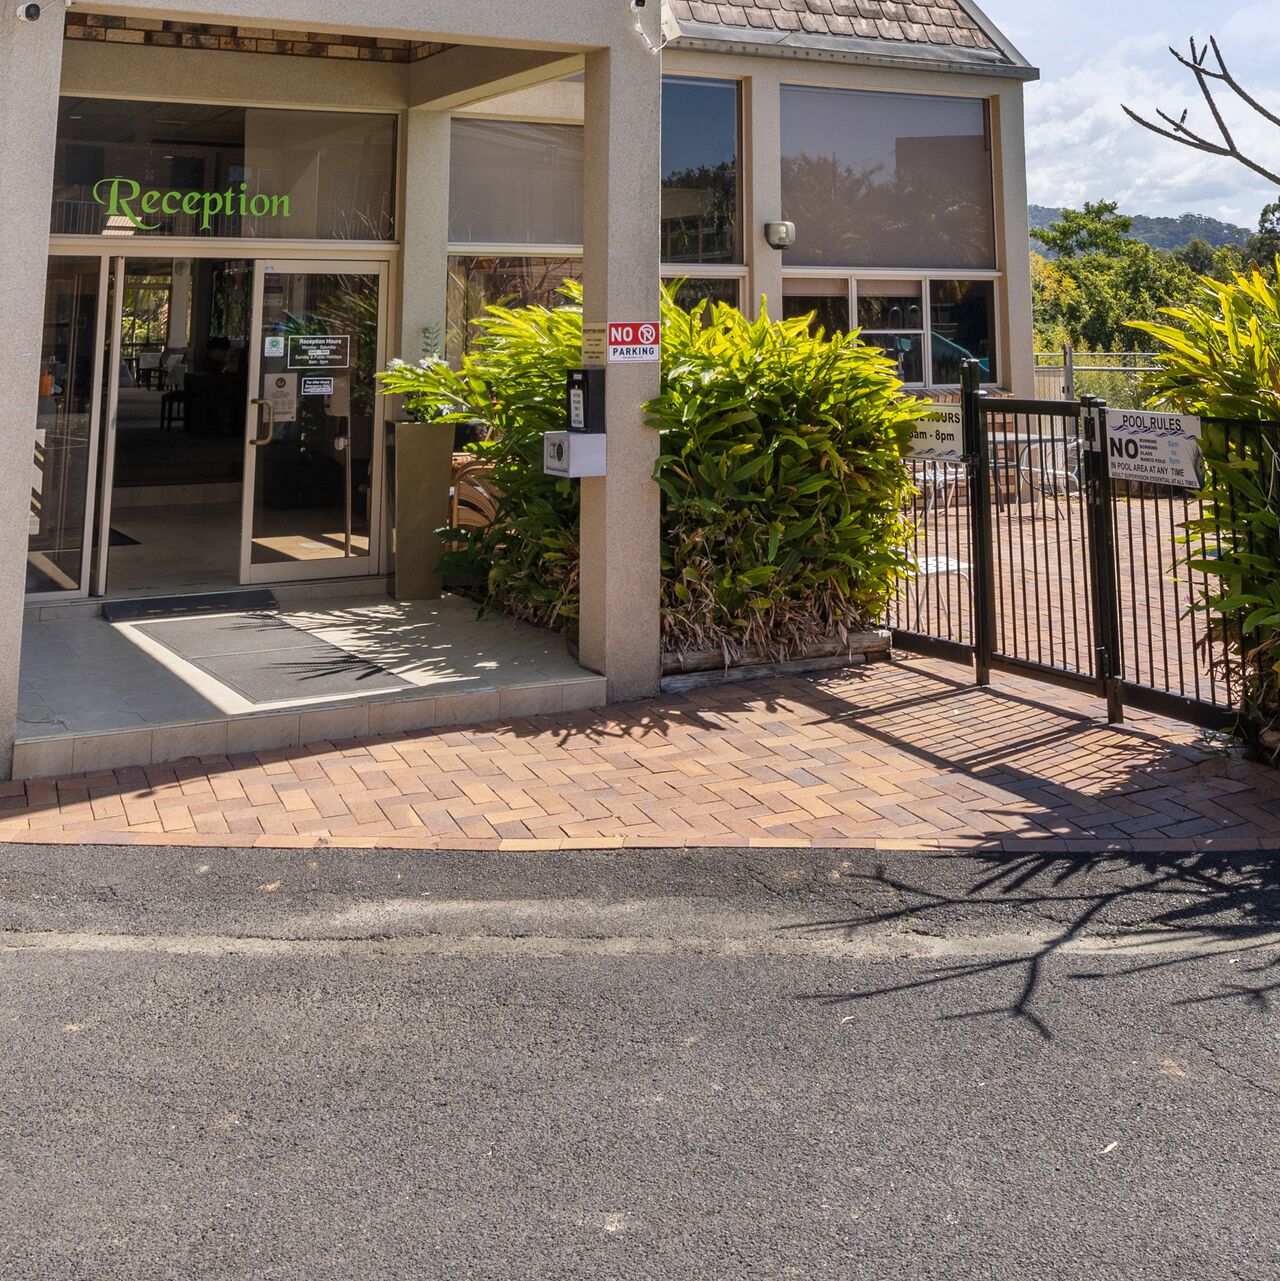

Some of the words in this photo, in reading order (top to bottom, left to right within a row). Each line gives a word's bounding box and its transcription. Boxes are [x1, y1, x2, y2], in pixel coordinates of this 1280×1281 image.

[93, 178, 291, 230] Reception
[611, 327, 633, 342] NO
[613, 347, 654, 356] PARKING
[1123, 415, 1148, 428] POOL
[1150, 417, 1181, 431] RULES
[935, 429, 955, 443] 8pm
[1110, 437, 1138, 459] NO
[1117, 462, 1132, 471] POOL
[1133, 464, 1149, 473] AREA
[1157, 467, 1169, 475] ANY
[1171, 468, 1184, 477] TIME
